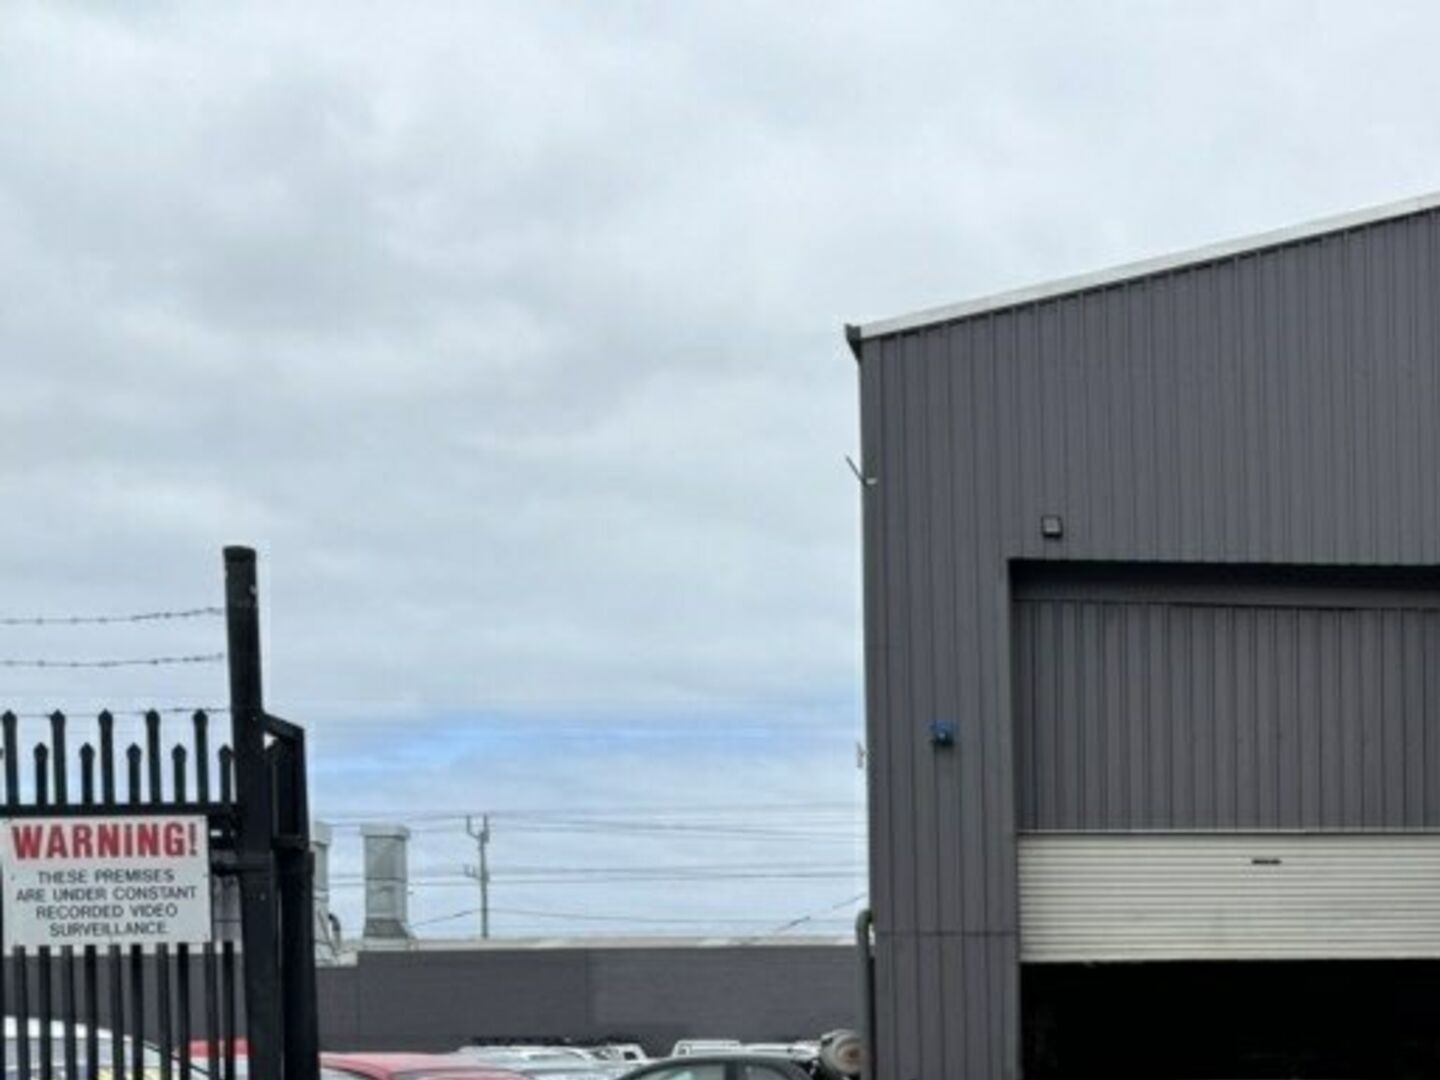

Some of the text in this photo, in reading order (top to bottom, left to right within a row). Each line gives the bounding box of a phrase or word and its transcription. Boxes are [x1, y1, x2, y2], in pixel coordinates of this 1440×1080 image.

[11, 822, 198, 860] WARNING!
[37, 868, 175, 885] THESE PREMISES
[16, 885, 198, 902] ARE UNDER CONSTANT
[36, 902, 179, 920] RECORDED VIDEO
[49, 921, 168, 937] SURVEILLANCE
